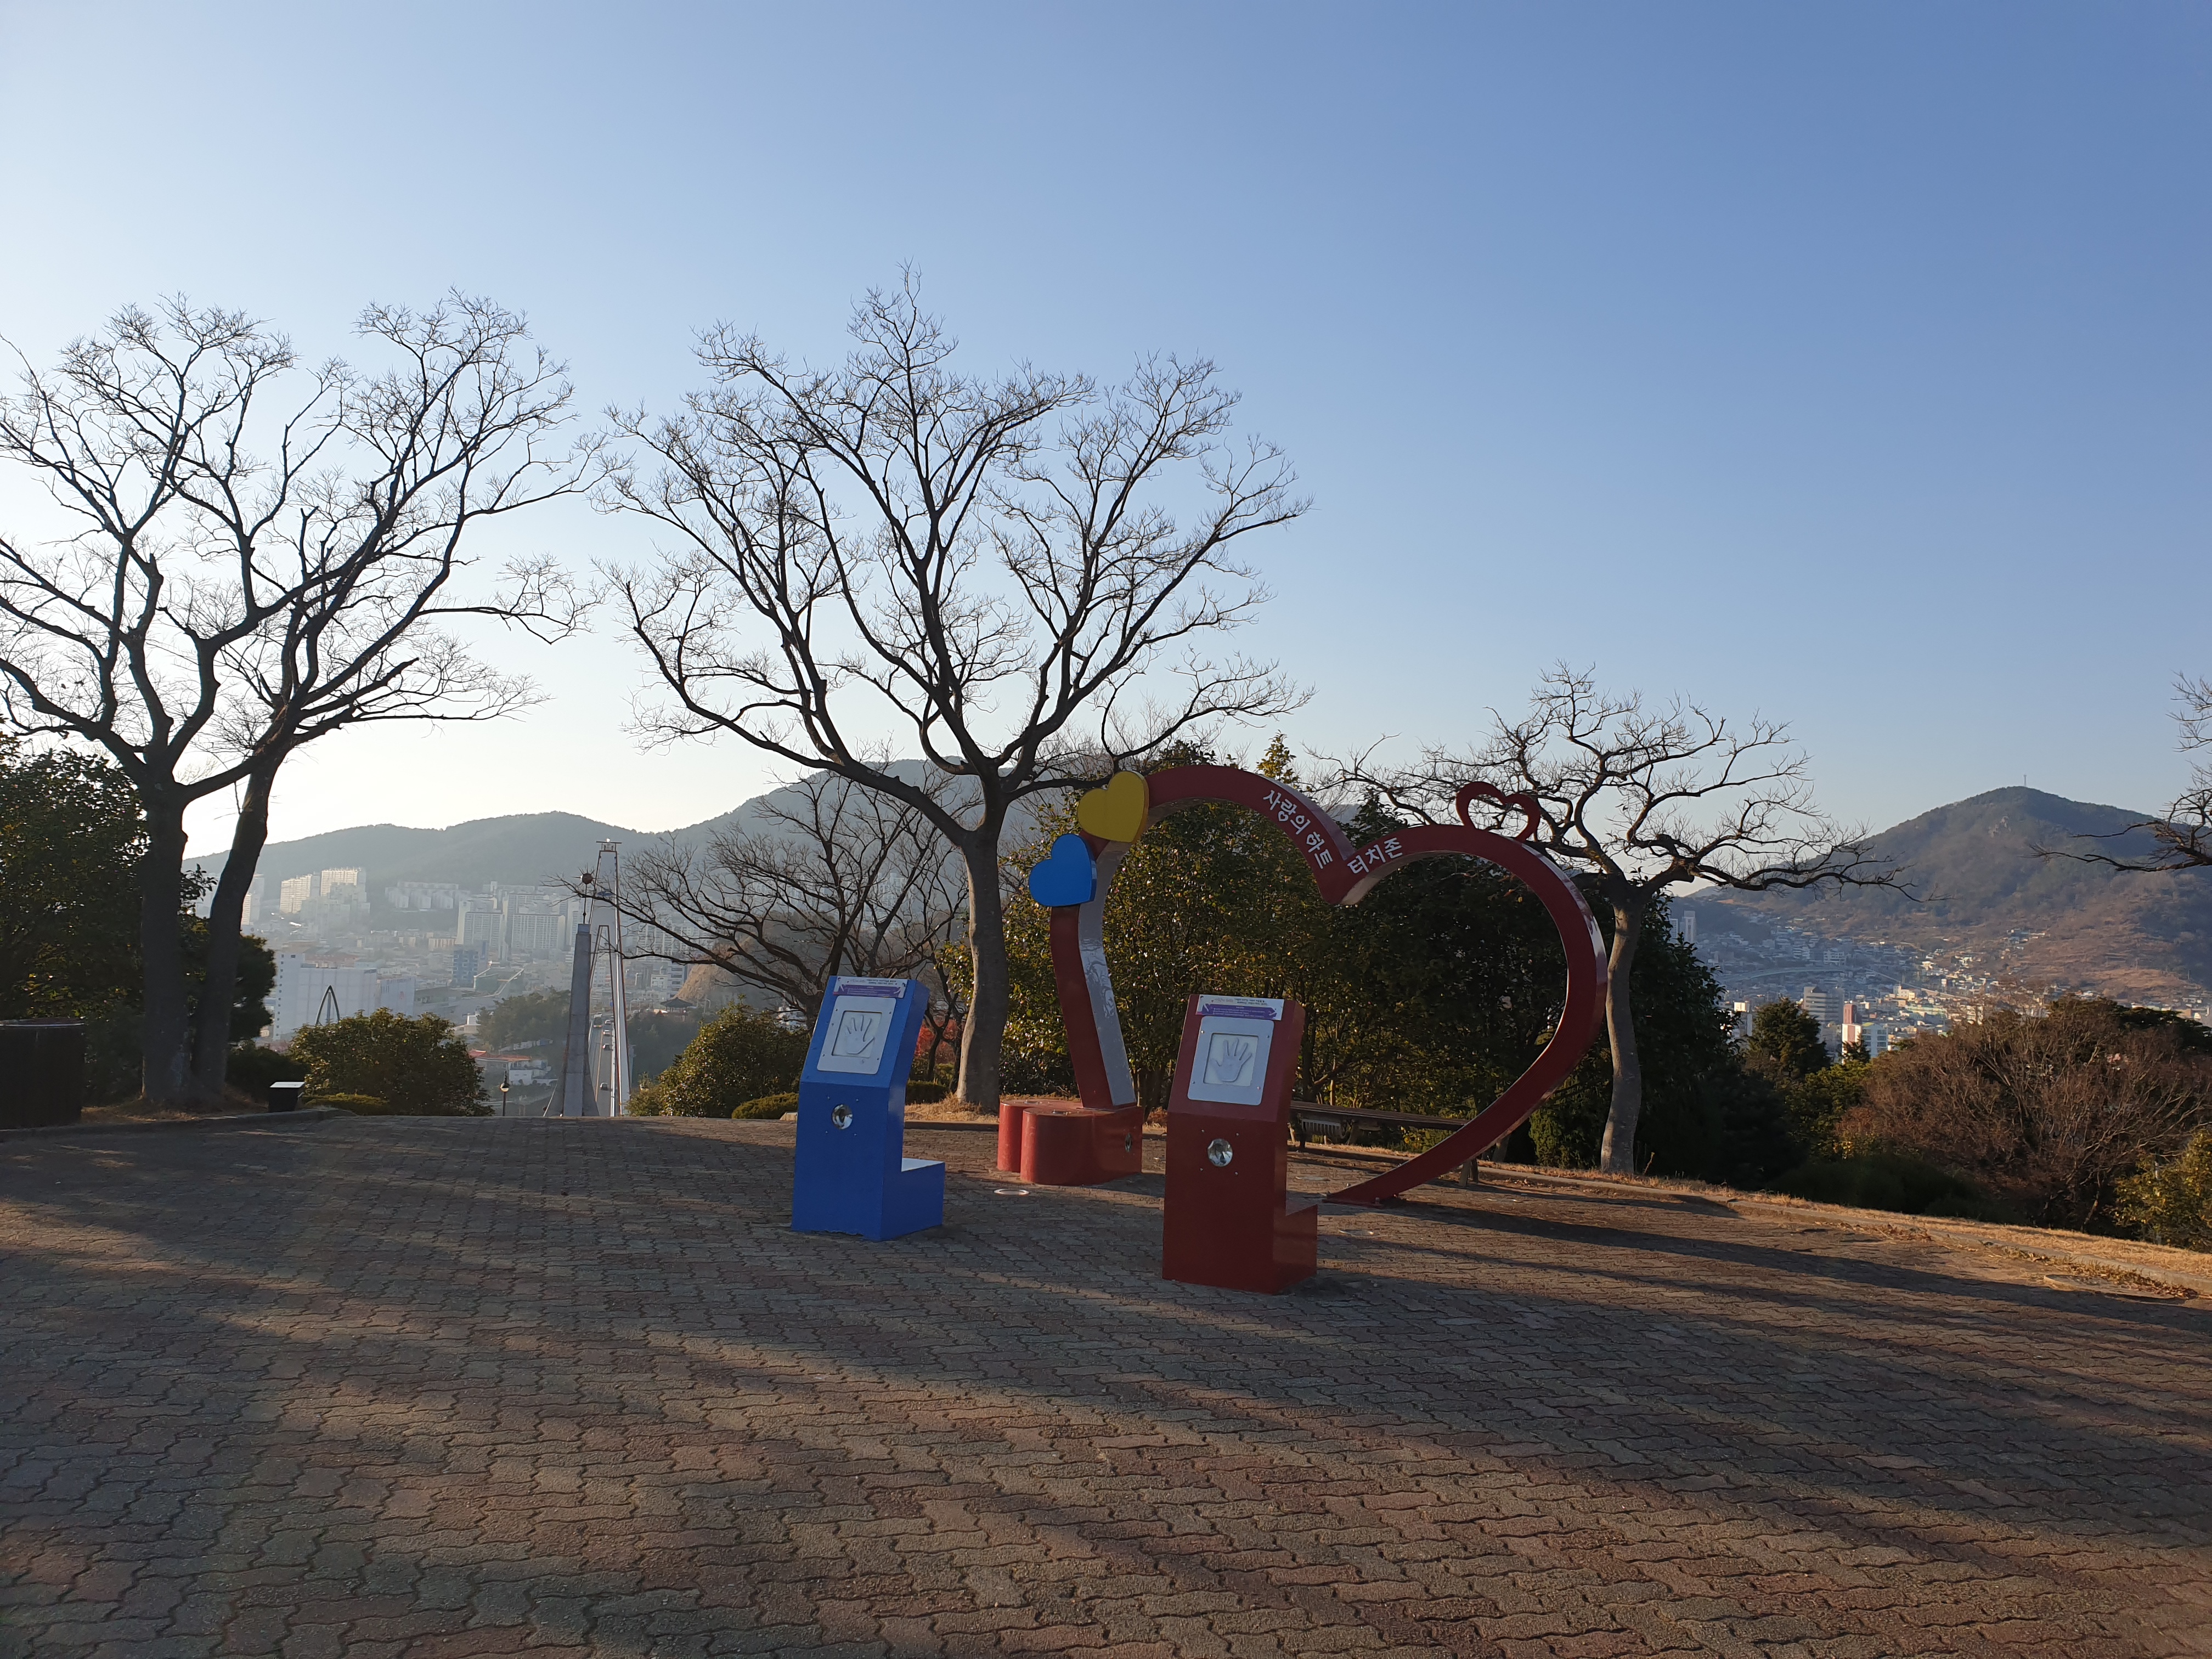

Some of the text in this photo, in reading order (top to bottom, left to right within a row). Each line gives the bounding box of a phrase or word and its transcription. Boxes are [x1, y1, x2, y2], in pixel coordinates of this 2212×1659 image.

[1263, 790, 1403, 874] 사랑의 하트 터치존
